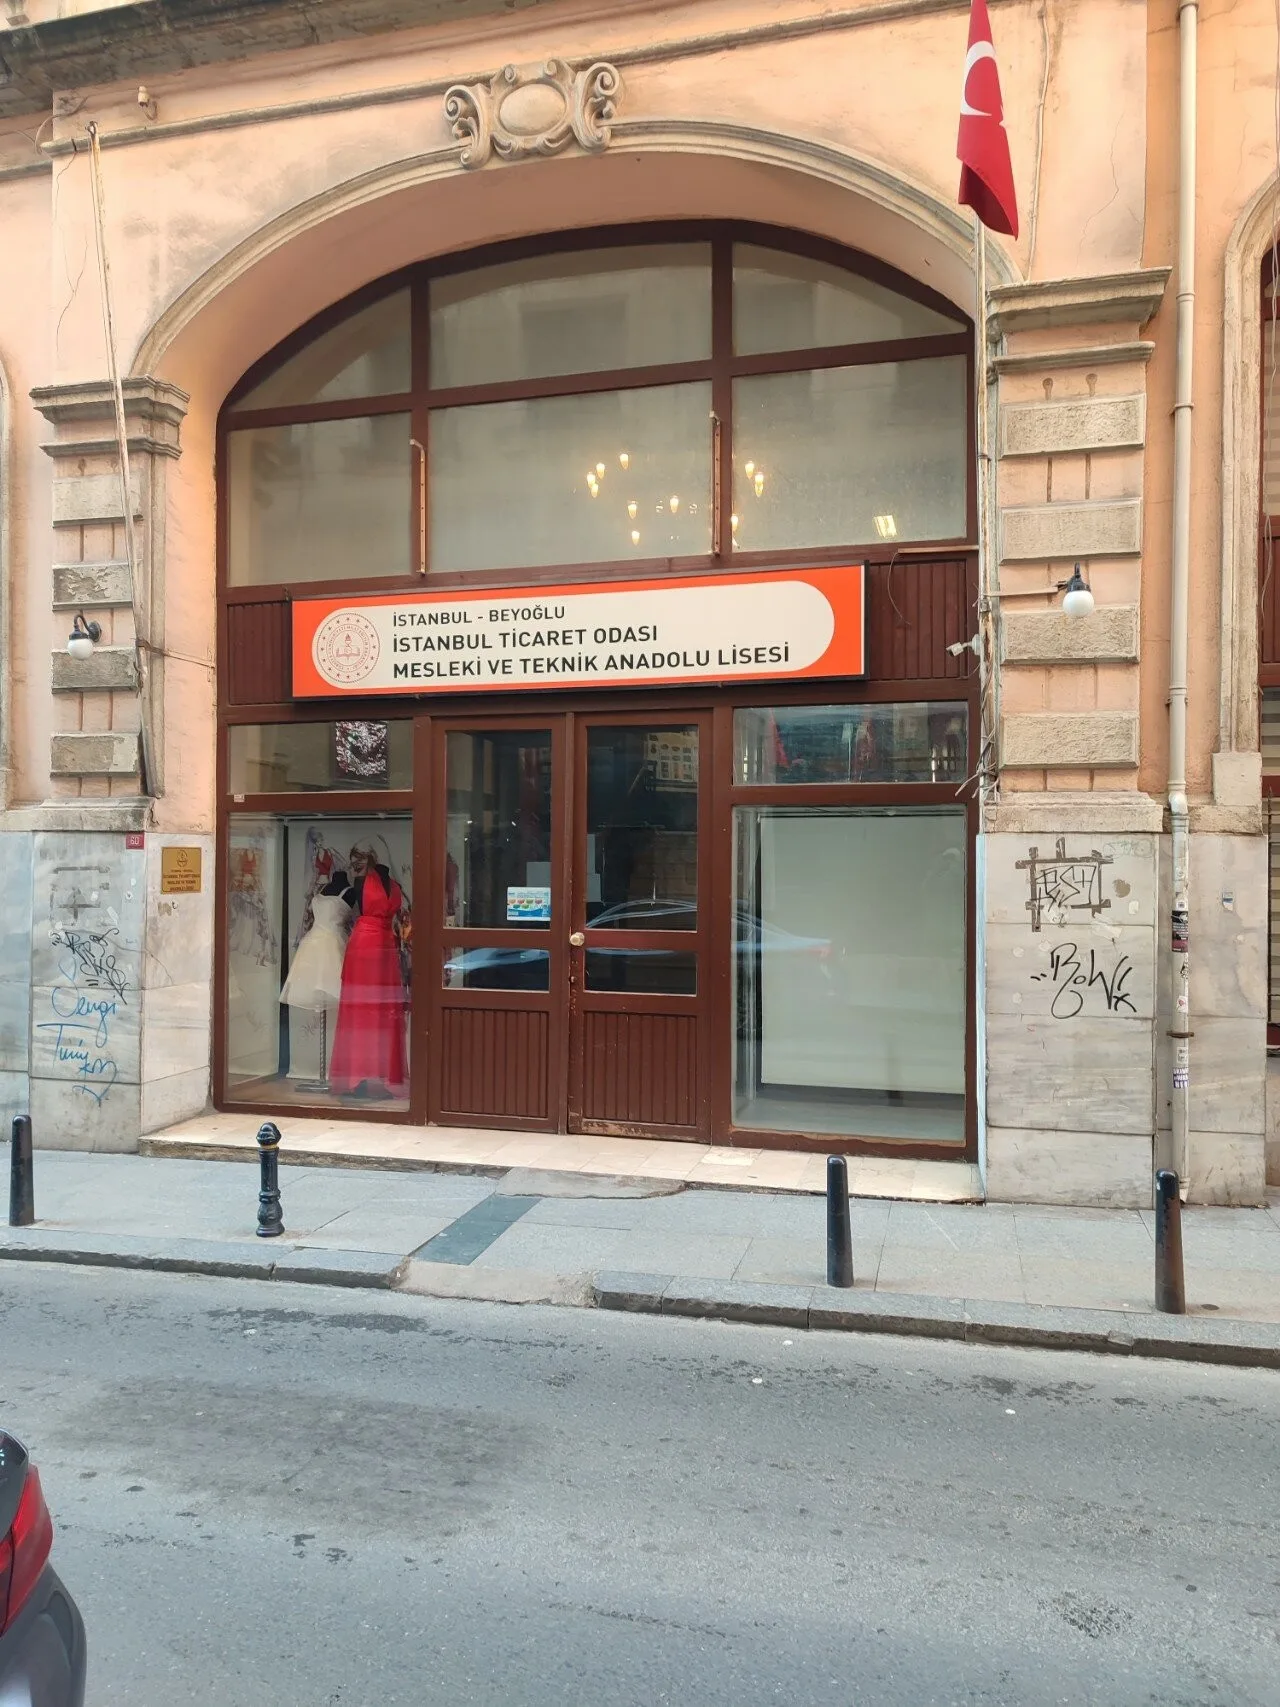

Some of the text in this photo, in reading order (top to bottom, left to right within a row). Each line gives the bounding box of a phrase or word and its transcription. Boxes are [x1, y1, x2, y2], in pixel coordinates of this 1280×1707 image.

[393, 611, 473, 627] İSTANBUL
[489, 604, 565, 623] BEYOĞLU
[393, 633, 493, 653] İSTANBUL
[498, 628, 587, 648] TİCARET
[593, 625, 657, 644] ODASI
[393, 641, 789, 679] MESLEKİ VE TEKNİK ANADOLU LİSESİ
